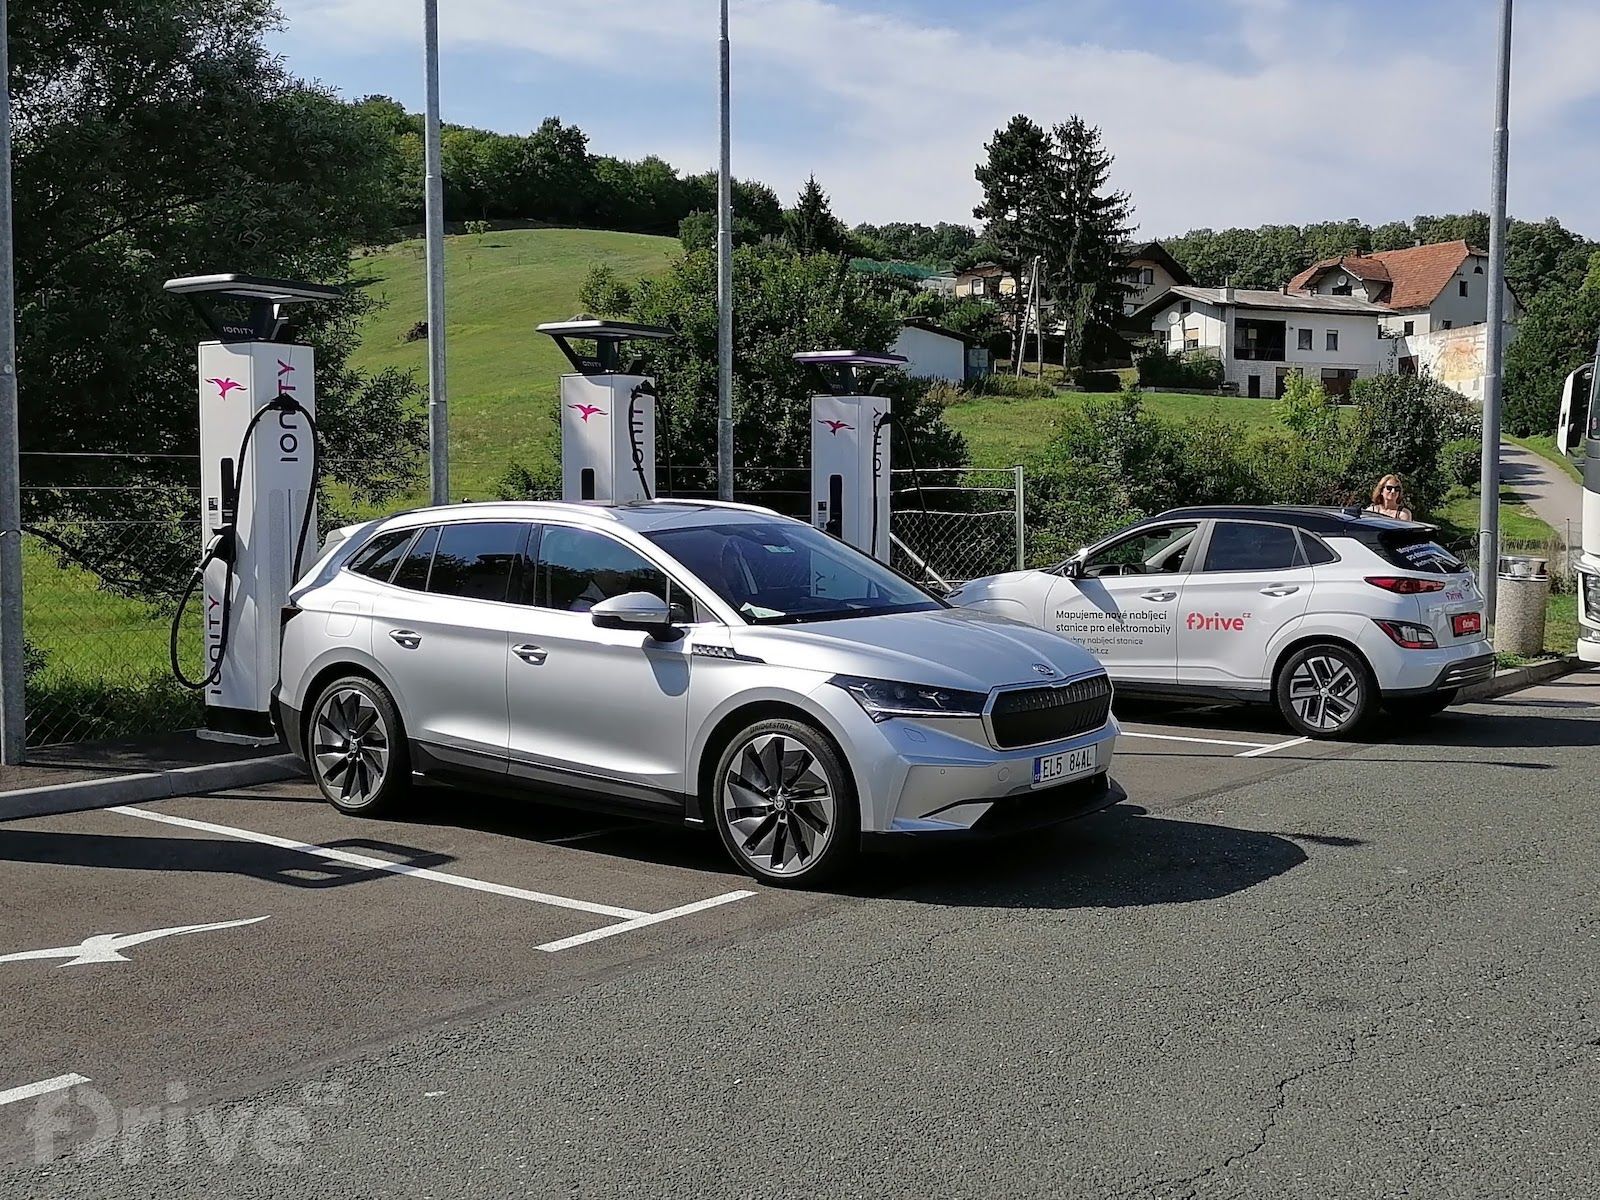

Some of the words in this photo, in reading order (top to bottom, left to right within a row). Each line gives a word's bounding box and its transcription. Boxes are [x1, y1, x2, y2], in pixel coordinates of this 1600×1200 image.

[277, 358, 299, 462] IONTY
[1055, 610, 1103, 621] Mapujeme
[1105, 610, 1128, 620] nové
[1129, 609, 1168, 621] nabíjecí
[1186, 612, 1245, 631] fDrive
[1056, 622, 1088, 633] stanice
[1090, 624, 1105, 634] pro
[1107, 623, 1171, 635] elektromobily
[1116, 637, 1144, 645] stanice
[750, 722, 793, 734] BRIDGESTONE
[1043, 756, 1062, 779] EL5
[1069, 748, 1092, 771] 84AL
